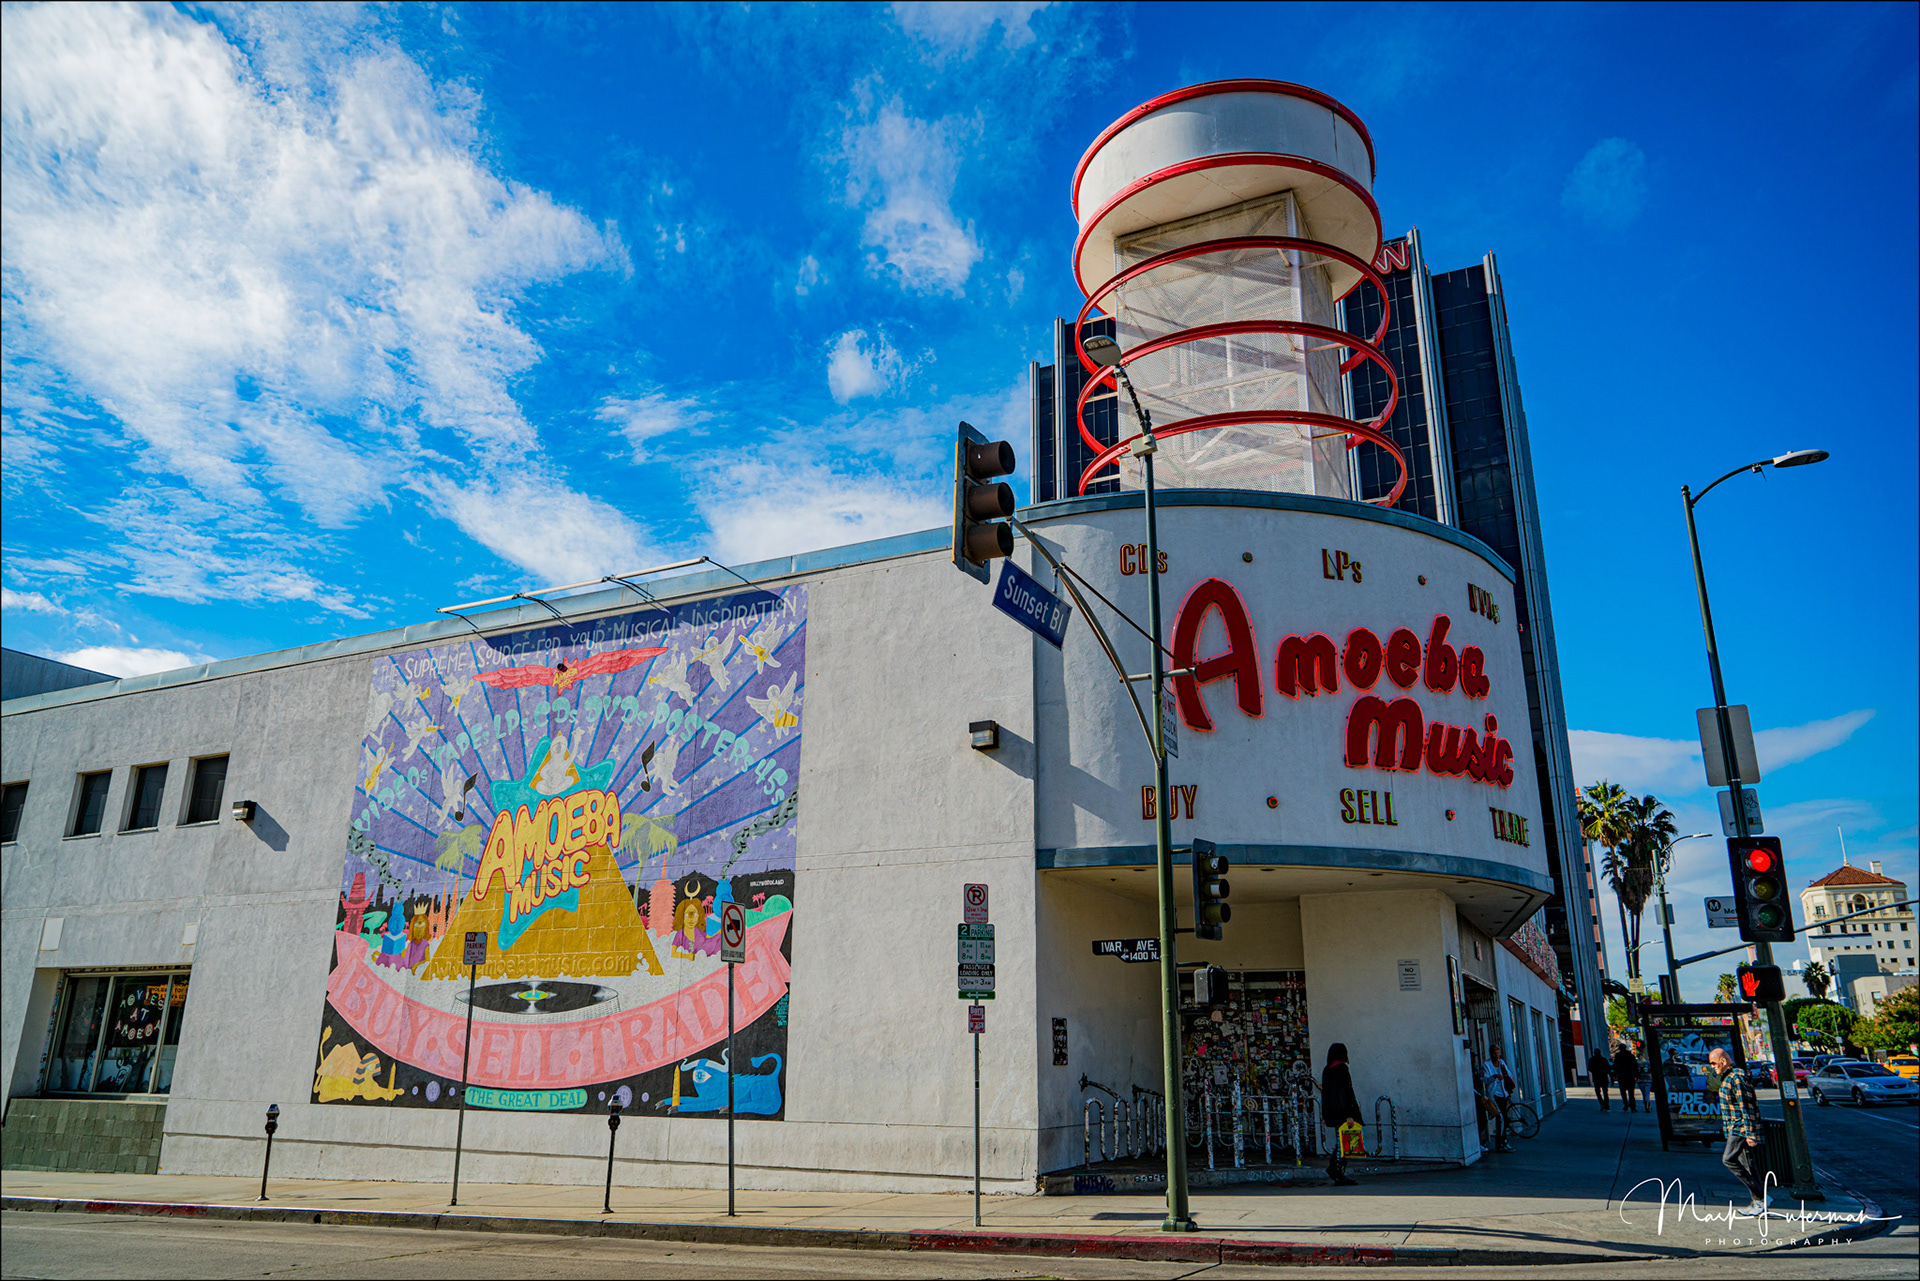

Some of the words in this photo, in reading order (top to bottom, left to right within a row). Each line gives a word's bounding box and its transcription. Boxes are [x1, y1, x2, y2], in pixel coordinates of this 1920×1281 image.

[1321, 548, 1362, 584] LPs
[1004, 575, 1049, 624] Sunset
[1049, 607, 1064, 633] Bl
[381, 665, 399, 684] THE
[405, 652, 467, 680] SUPREME
[478, 640, 531, 668] SOURCE
[536, 636, 562, 660] FOR
[570, 628, 605, 654] YOUR
[612, 616, 681, 647] MUSICAL
[691, 595, 797, 634] INSPIRATION
[1171, 577, 1490, 732] Amoeba
[1344, 693, 1514, 789] Music
[1141, 785, 1197, 820] BUY
[1339, 788, 1399, 826] SELL
[1489, 806, 1530, 848] TRADE
[473, 789, 622, 902] AMOEBA
[509, 850, 592, 924] MUSIC
[467, 933, 475, 941] NO
[961, 925, 968, 935] 2
[971, 928, 993, 938] PARKING
[466, 942, 485, 950] PARKING
[1101, 941, 1122, 953] IVAR
[1136, 940, 1157, 951] AVE.
[1130, 952, 1149, 960] 1400
[1151, 951, 1160, 960] N.
[434, 954, 631, 979] wwwamoebamusic.com
[120, 988, 165, 1010] MOVIES
[130, 1008, 149, 1021] AT
[335, 960, 437, 1058] BUY
[446, 1021, 567, 1081] SELL
[579, 943, 777, 1076] TRADE
[115, 1020, 160, 1040] AMOEBA
[469, 1091, 493, 1105] THE
[498, 1091, 543, 1107] GREAT
[549, 1091, 585, 1107] DEAL
[1668, 1092, 1704, 1104] RIDE
[1679, 1103, 1721, 1115] ALON
